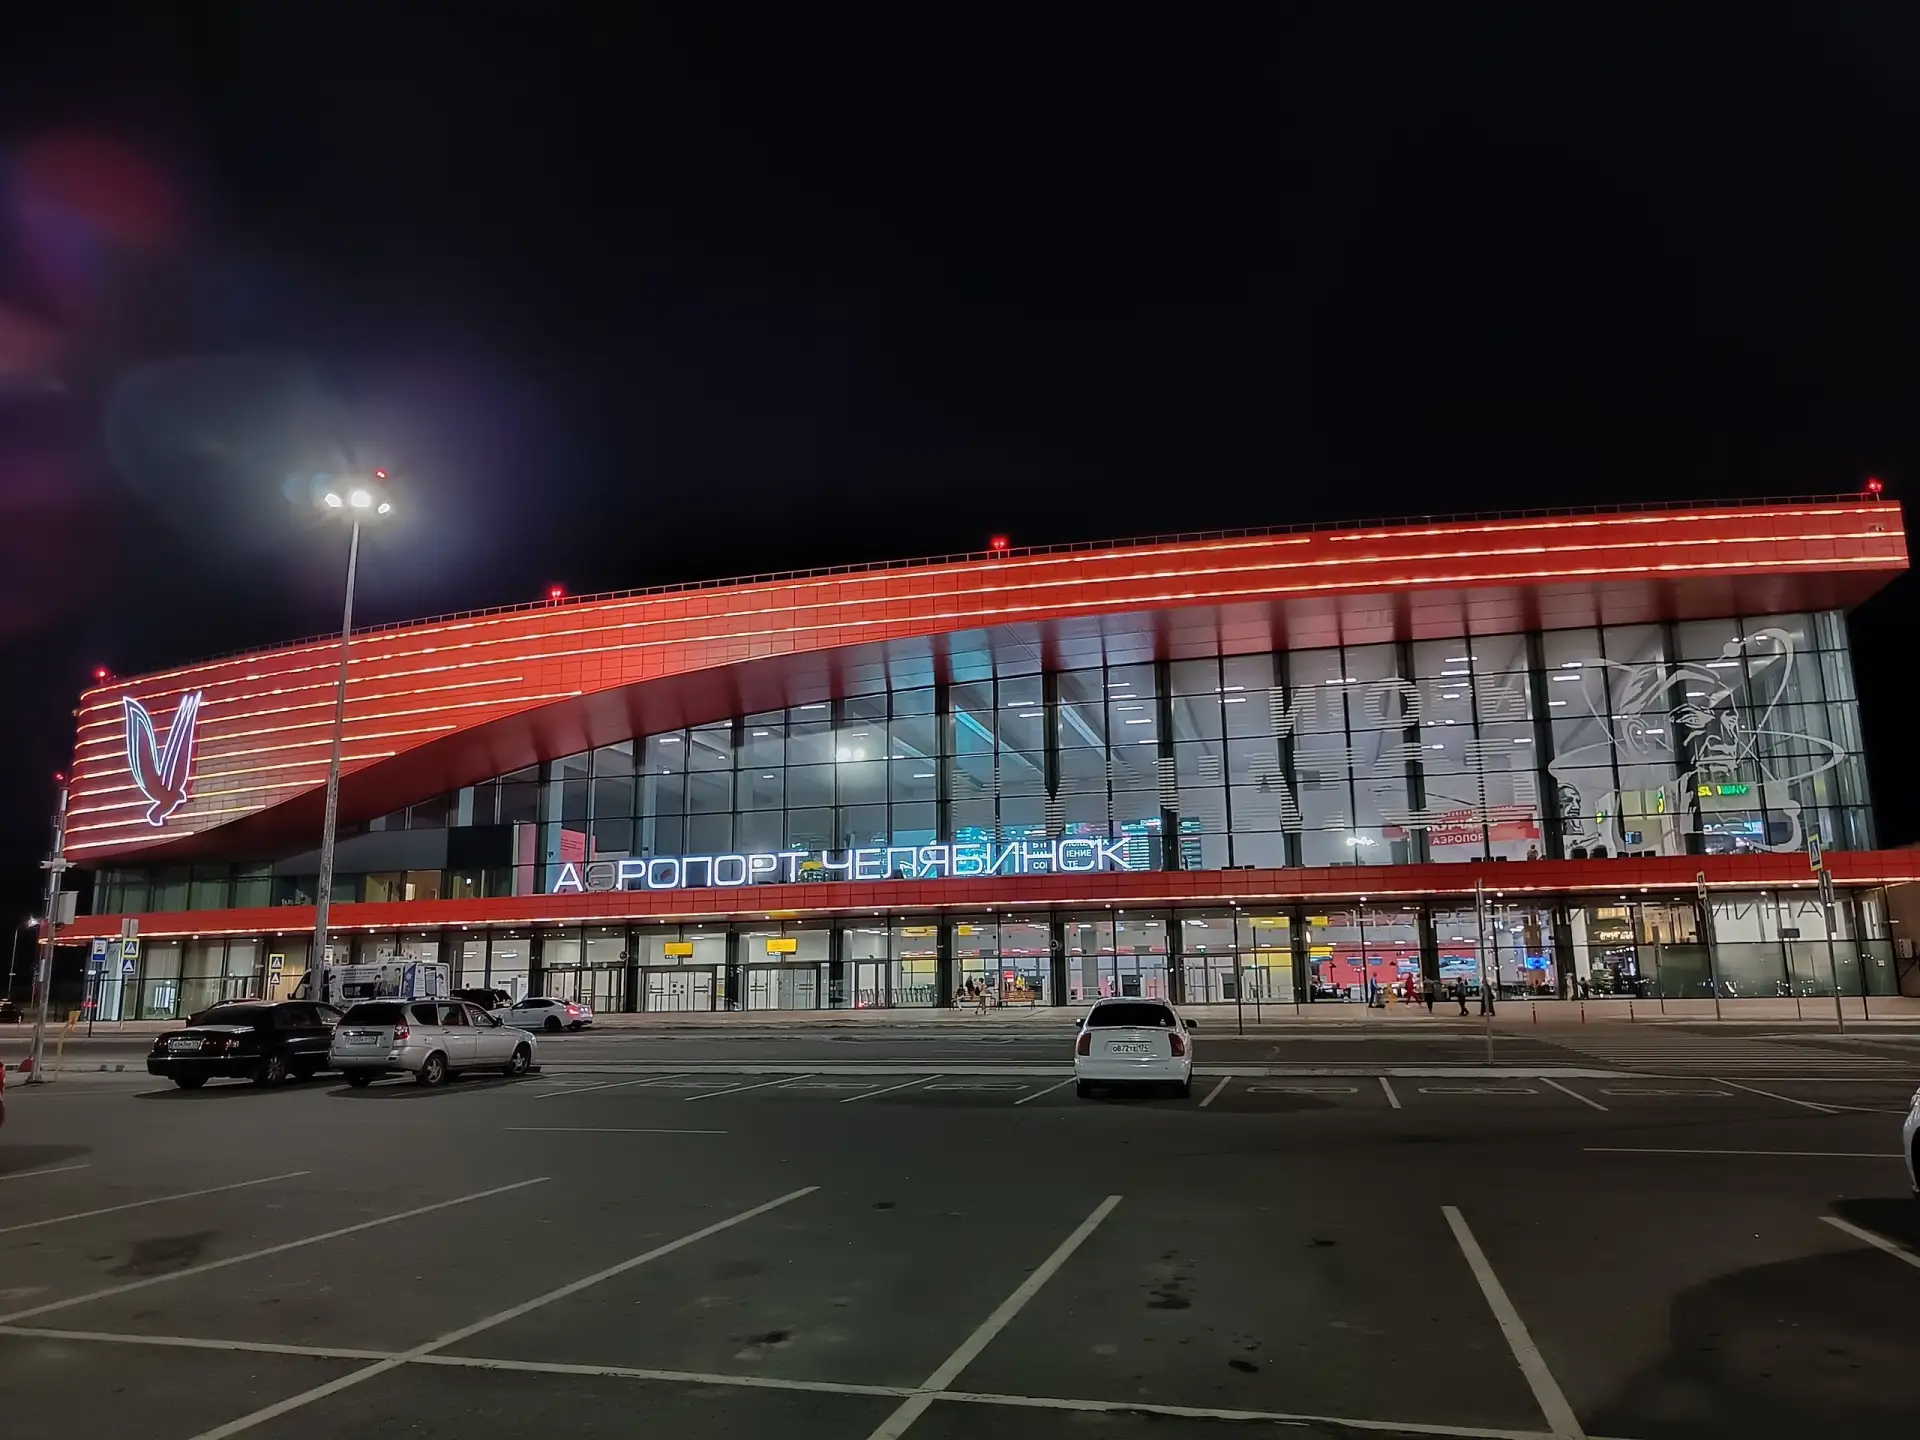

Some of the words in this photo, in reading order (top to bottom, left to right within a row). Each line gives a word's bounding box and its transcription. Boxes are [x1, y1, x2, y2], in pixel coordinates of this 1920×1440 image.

[1432, 833, 1491, 845] АЭРОПОР
[553, 852, 809, 893] АЭРОПОРТ
[822, 837, 1133, 881] ЧЕЛЯБИНСК
[1612, 896, 1829, 925] ТЕРМИНА
